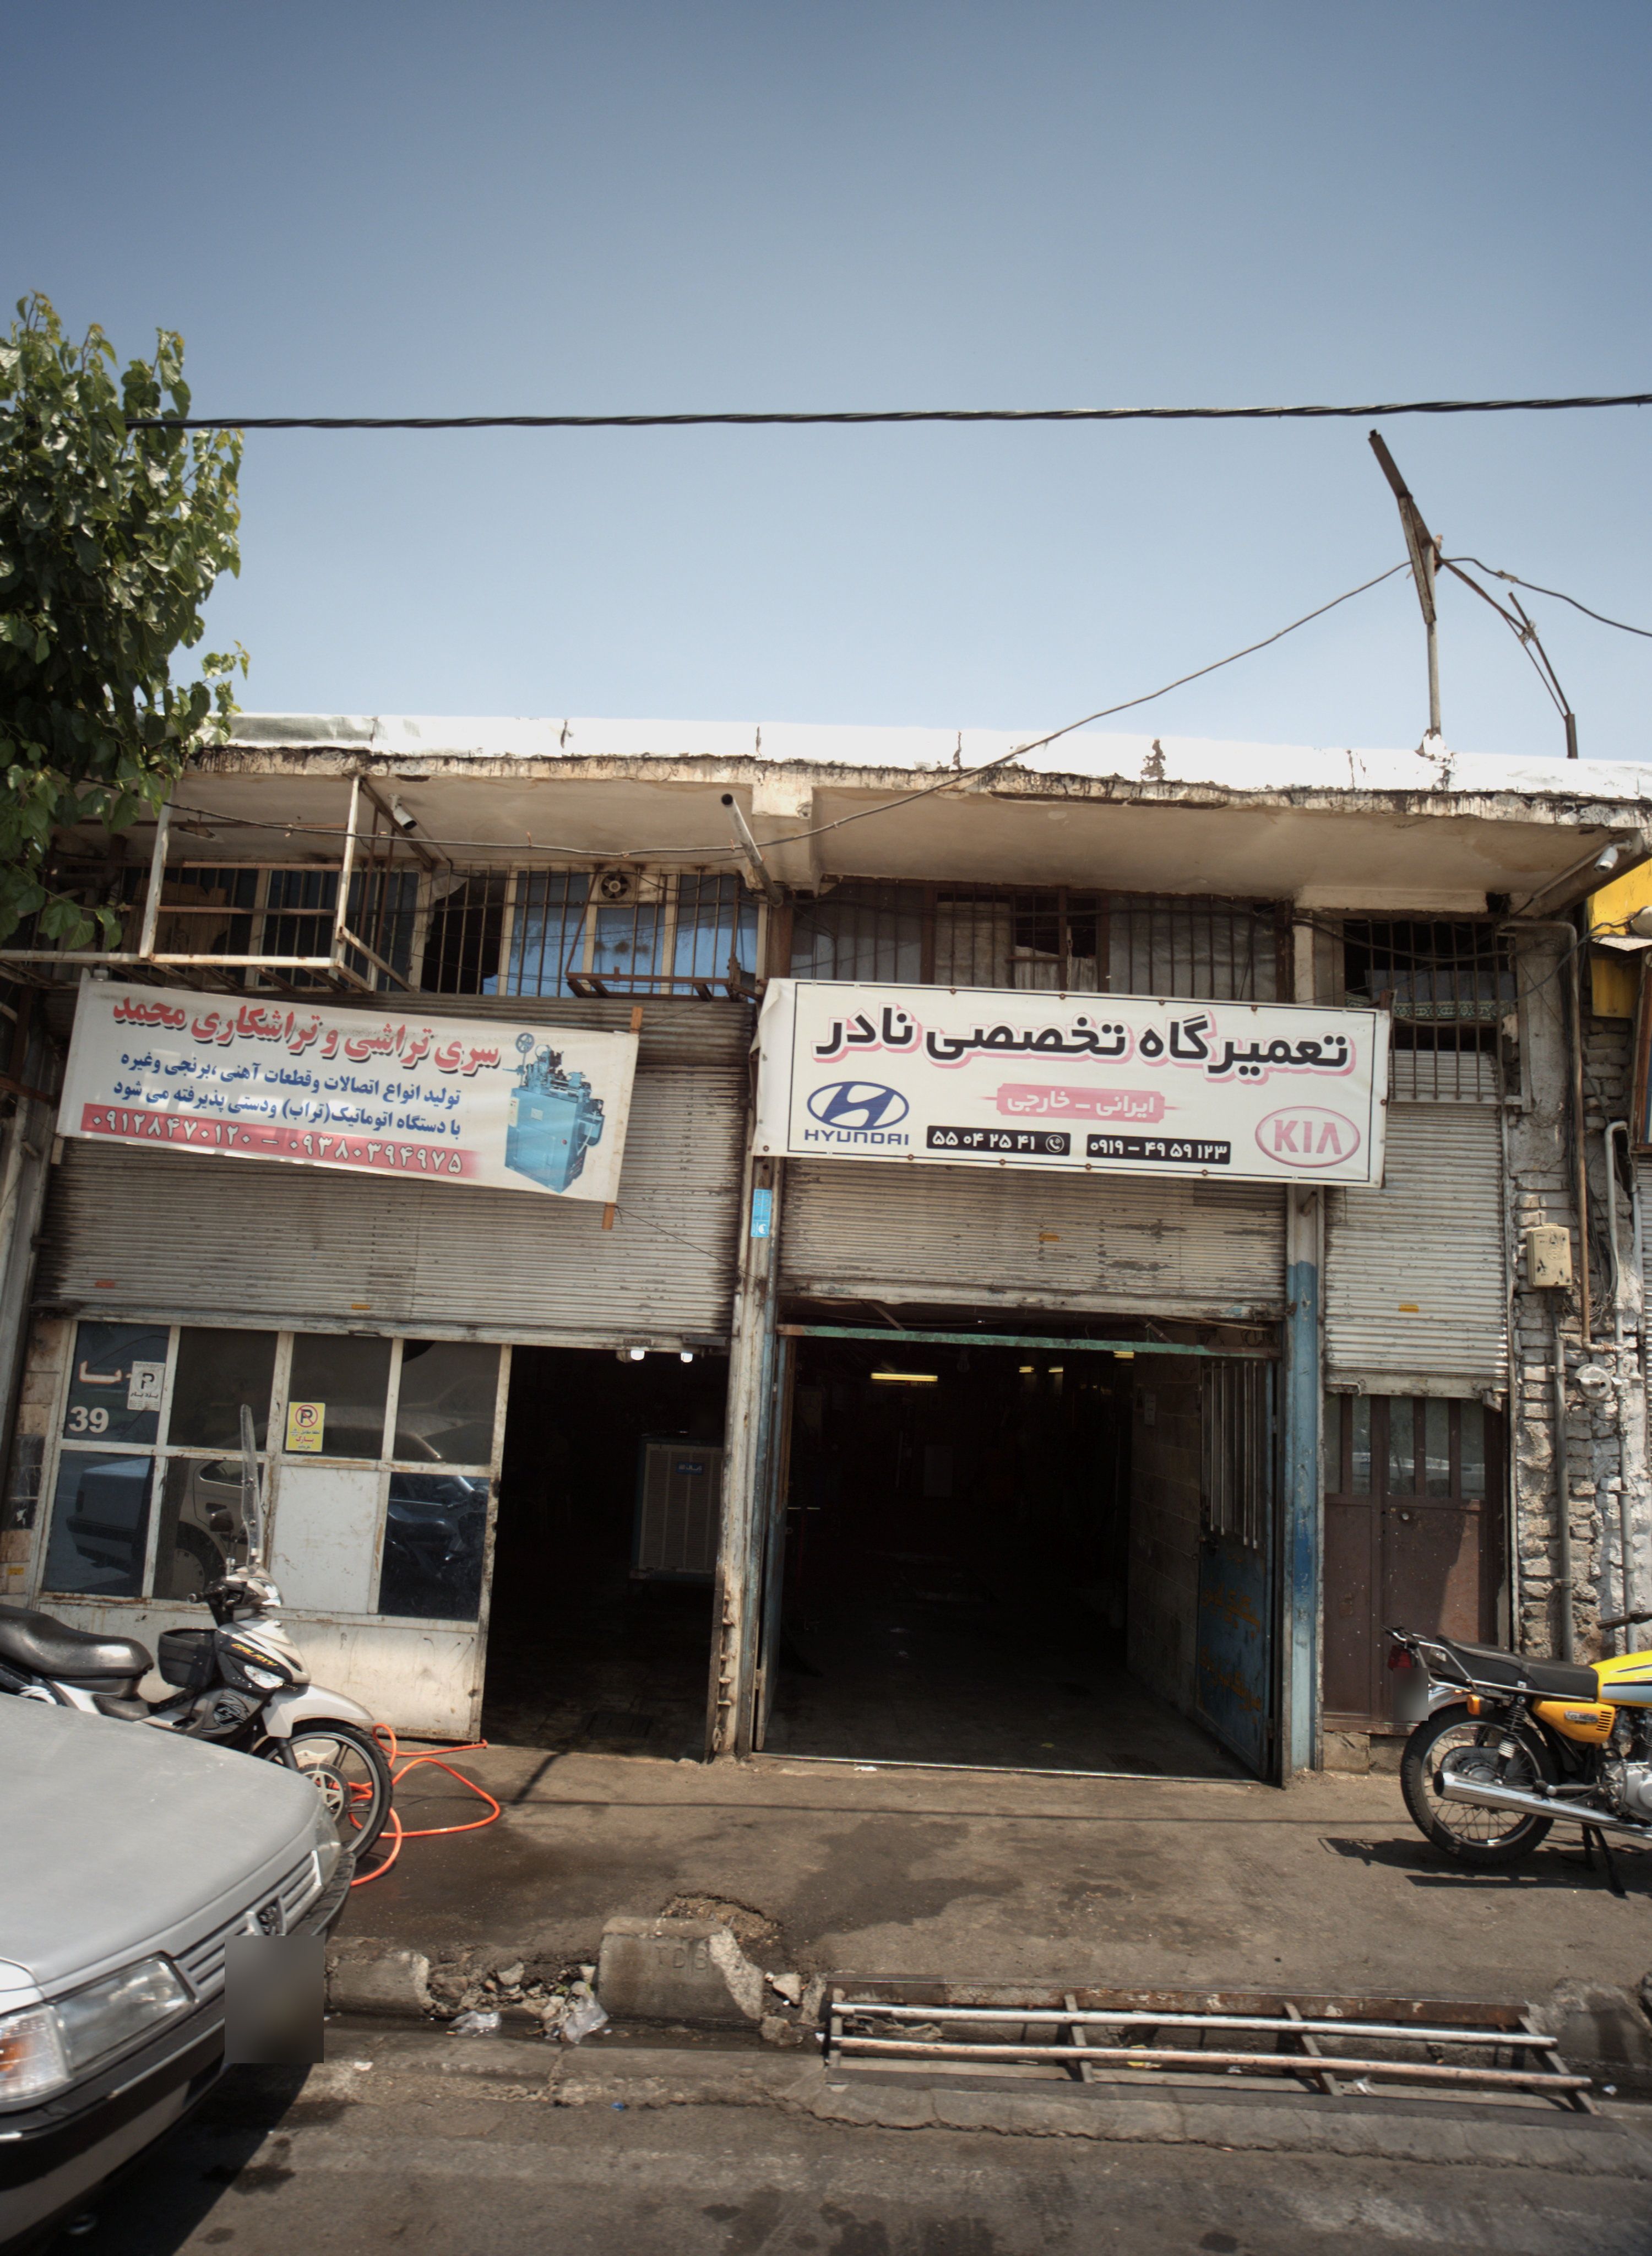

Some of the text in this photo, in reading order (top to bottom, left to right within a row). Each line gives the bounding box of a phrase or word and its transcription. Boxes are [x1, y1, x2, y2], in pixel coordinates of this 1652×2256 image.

[113, 996, 500, 1076] سری تراشی و تراشکاری محمد
[816, 1007, 1348, 1076] تعمیرگاه تخصصی نادر
[220, 1062, 262, 1082] آهنی
[113, 1081, 143, 1100] شود
[324, 1075, 379, 1095] اتصالات
[382, 1082, 421, 1104] انواع
[145, 1090, 169, 1103] می
[173, 1086, 225, 1113] پذیرفته
[423, 1087, 461, 1109] تولید
[1007, 1090, 1070, 1113] خارجی
[1095, 1096, 1154, 1118] ایرانی
[396, 1114, 446, 1134] دستگاه
[450, 1119, 461, 1140] با
[93, 1109, 251, 1146] ۰۹۱۲۸۴۷۰۱۲۰
[289, 1134, 462, 1174] ۰۹۳۸۰۳۹۴۹۷۵
[804, 1129, 909, 1146] HYUNDAI
[1274, 1119, 1343, 1155] KIA
[68, 1406, 110, 1434] 39
